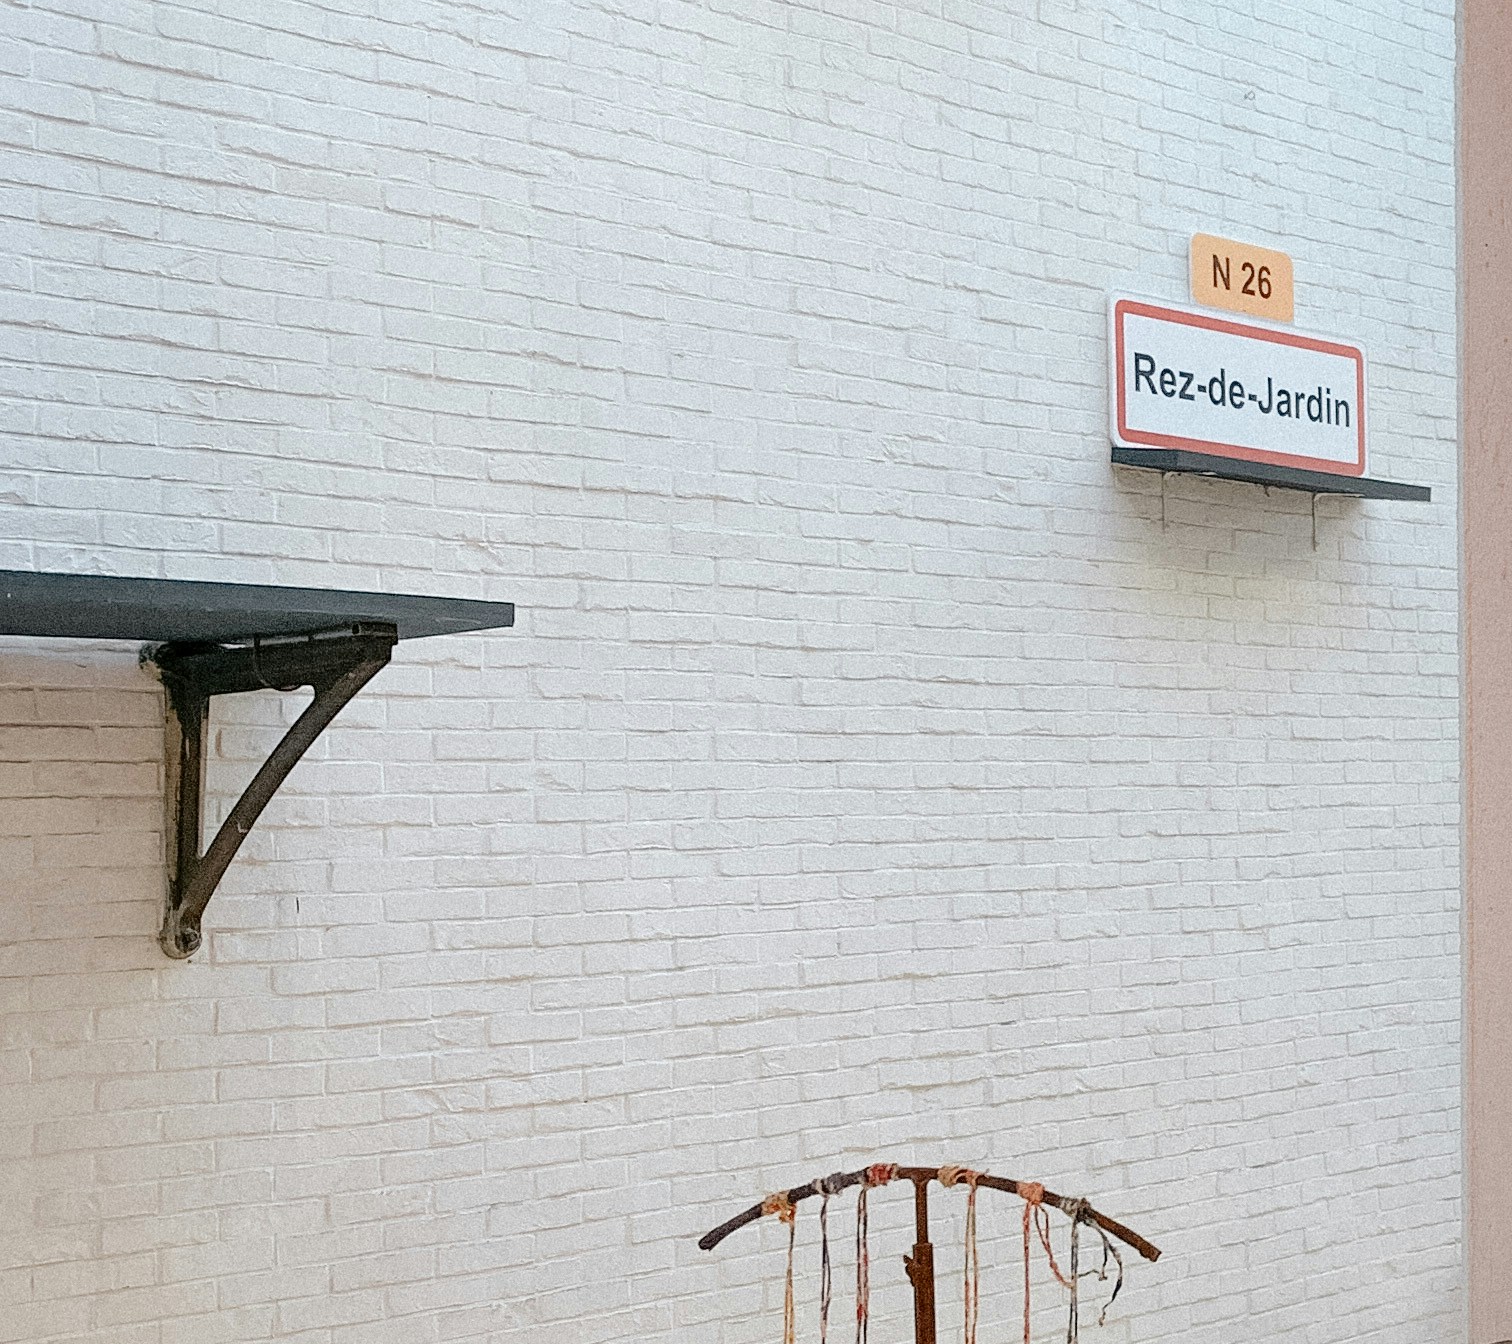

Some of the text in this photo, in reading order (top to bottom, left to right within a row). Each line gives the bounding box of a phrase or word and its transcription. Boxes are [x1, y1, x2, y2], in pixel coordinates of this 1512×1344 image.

[1212, 254, 1272, 299] N 26
[1133, 351, 1351, 428] Rez-de-Jardin
